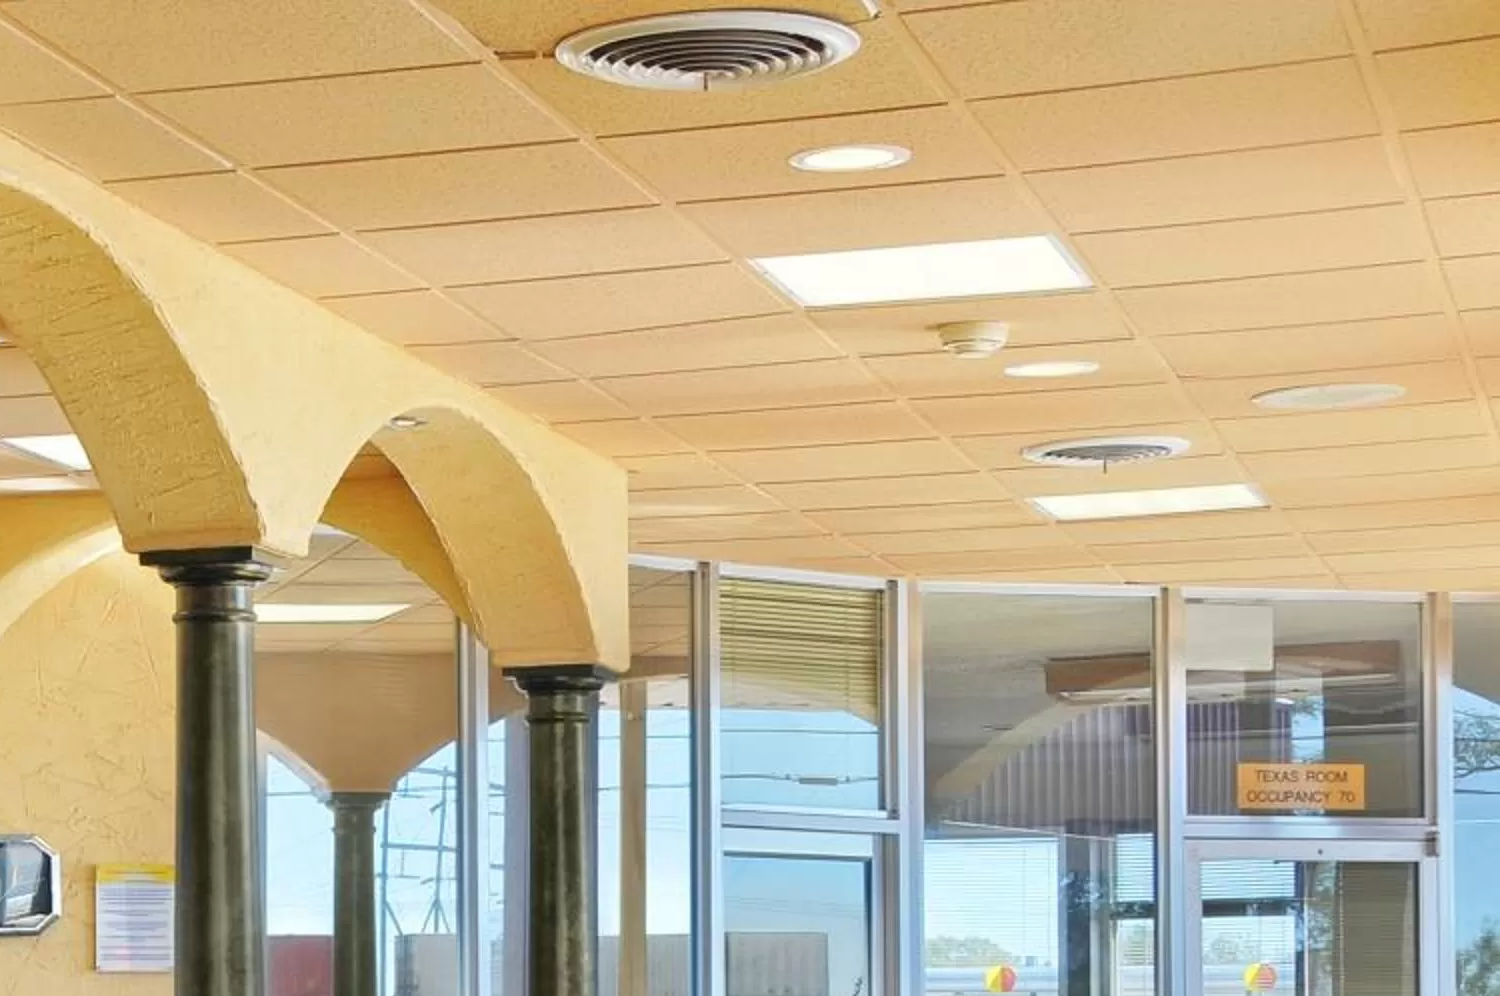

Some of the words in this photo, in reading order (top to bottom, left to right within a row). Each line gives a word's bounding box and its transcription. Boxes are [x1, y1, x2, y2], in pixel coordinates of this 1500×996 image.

[1255, 769, 1299, 783] TEXAS
[1306, 770, 1348, 783] ROOM
[1246, 789, 1330, 803] OCCUPANCY
